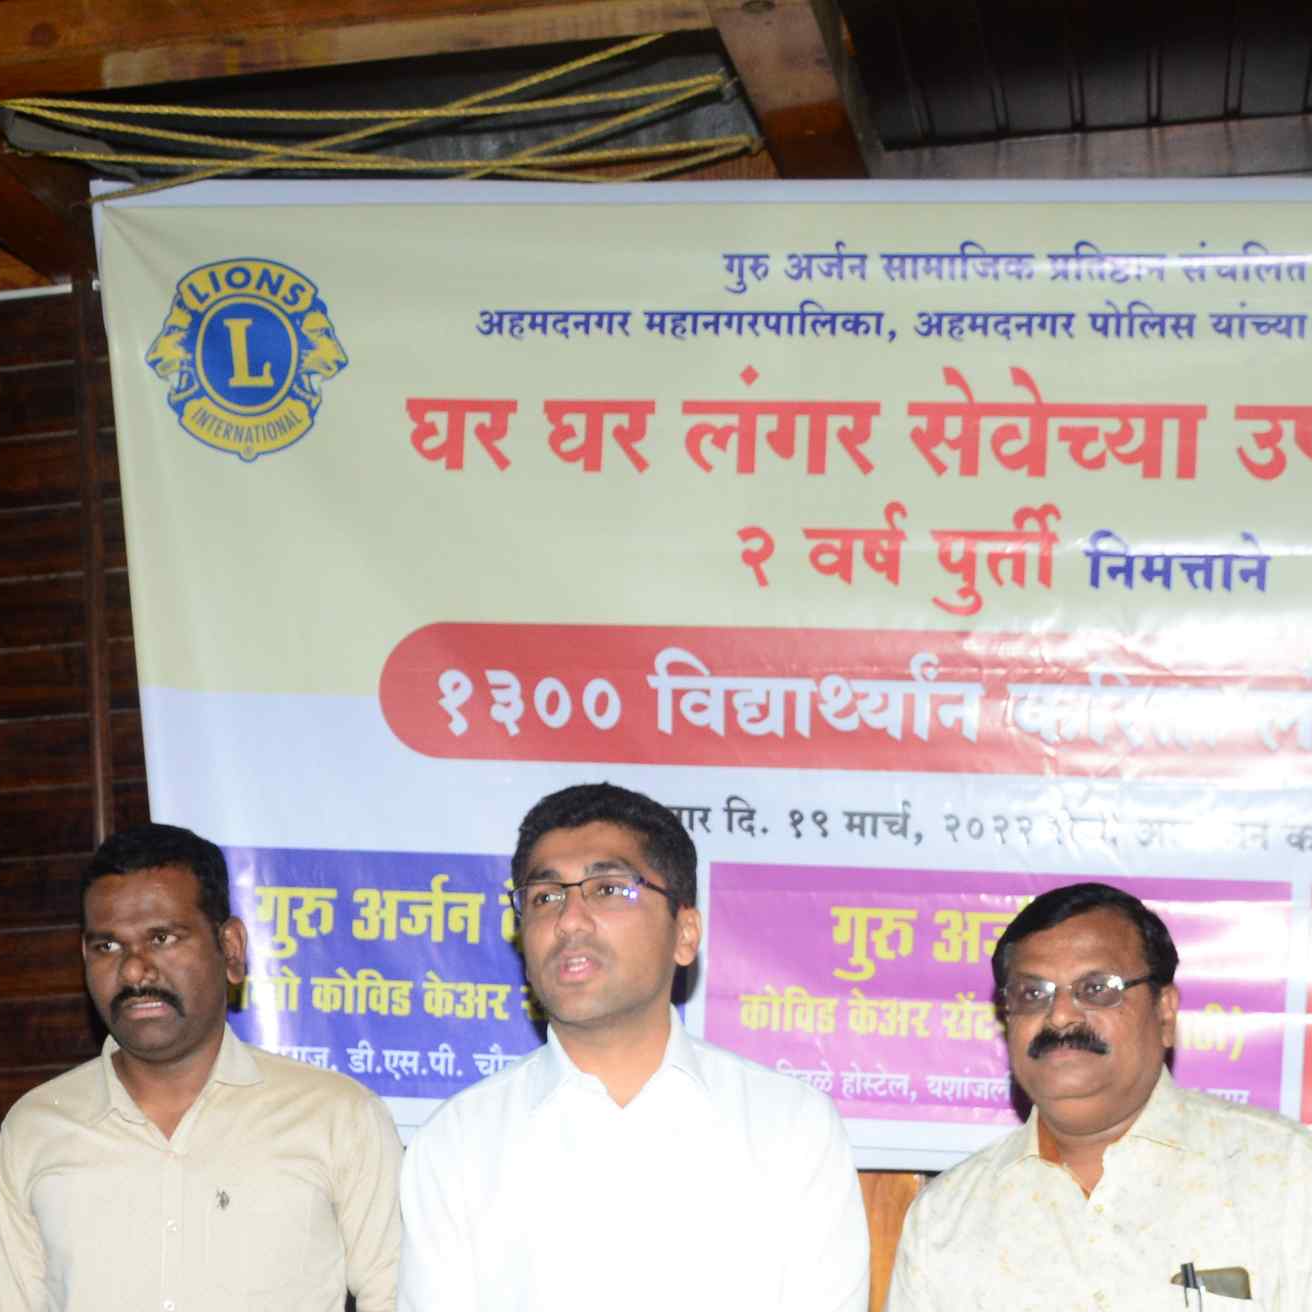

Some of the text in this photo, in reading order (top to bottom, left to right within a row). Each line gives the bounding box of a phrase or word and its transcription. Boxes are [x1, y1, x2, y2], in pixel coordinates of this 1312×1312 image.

[187, 266, 307, 306] LIONS
[722, 253, 770, 294] गुरु
[784, 240, 868, 281] अर्जन
[879, 240, 1035, 282] सामाजिक
[474, 308, 633, 340] अहमदनगर
[643, 299, 897, 343] महानगरपालिका,
[914, 311, 1076, 342] अहमदनगर
[1088, 300, 1197, 340] पोलिस
[1209, 301, 1308, 340] यांच्या
[223, 318, 276, 388] L
[190, 406, 303, 445] INTERNATIONAL
[405, 396, 518, 471] घर
[544, 398, 656, 473] घर
[682, 364, 882, 477] लंगर
[907, 366, 1207, 481] सेवेच्या
[736, 524, 776, 588] २
[802, 501, 908, 586] वर्ष
[930, 502, 1062, 617] पुर्ती
[437, 668, 623, 738] १३००
[724, 795, 769, 838] दि.
[788, 809, 830, 839] १९
[841, 800, 924, 846] मार्च,
[944, 811, 1033, 846] २०२२
[254, 885, 338, 960] गुरु
[352, 873, 486, 945] अर्जन
[830, 905, 919, 982] गुरु
[310, 967, 414, 1016] कोविड
[423, 970, 512, 1021] केअर
[739, 985, 840, 1034] कोविड
[847, 987, 933, 1039] केअर
[346, 1039, 464, 1080] डी.एस.पी.
